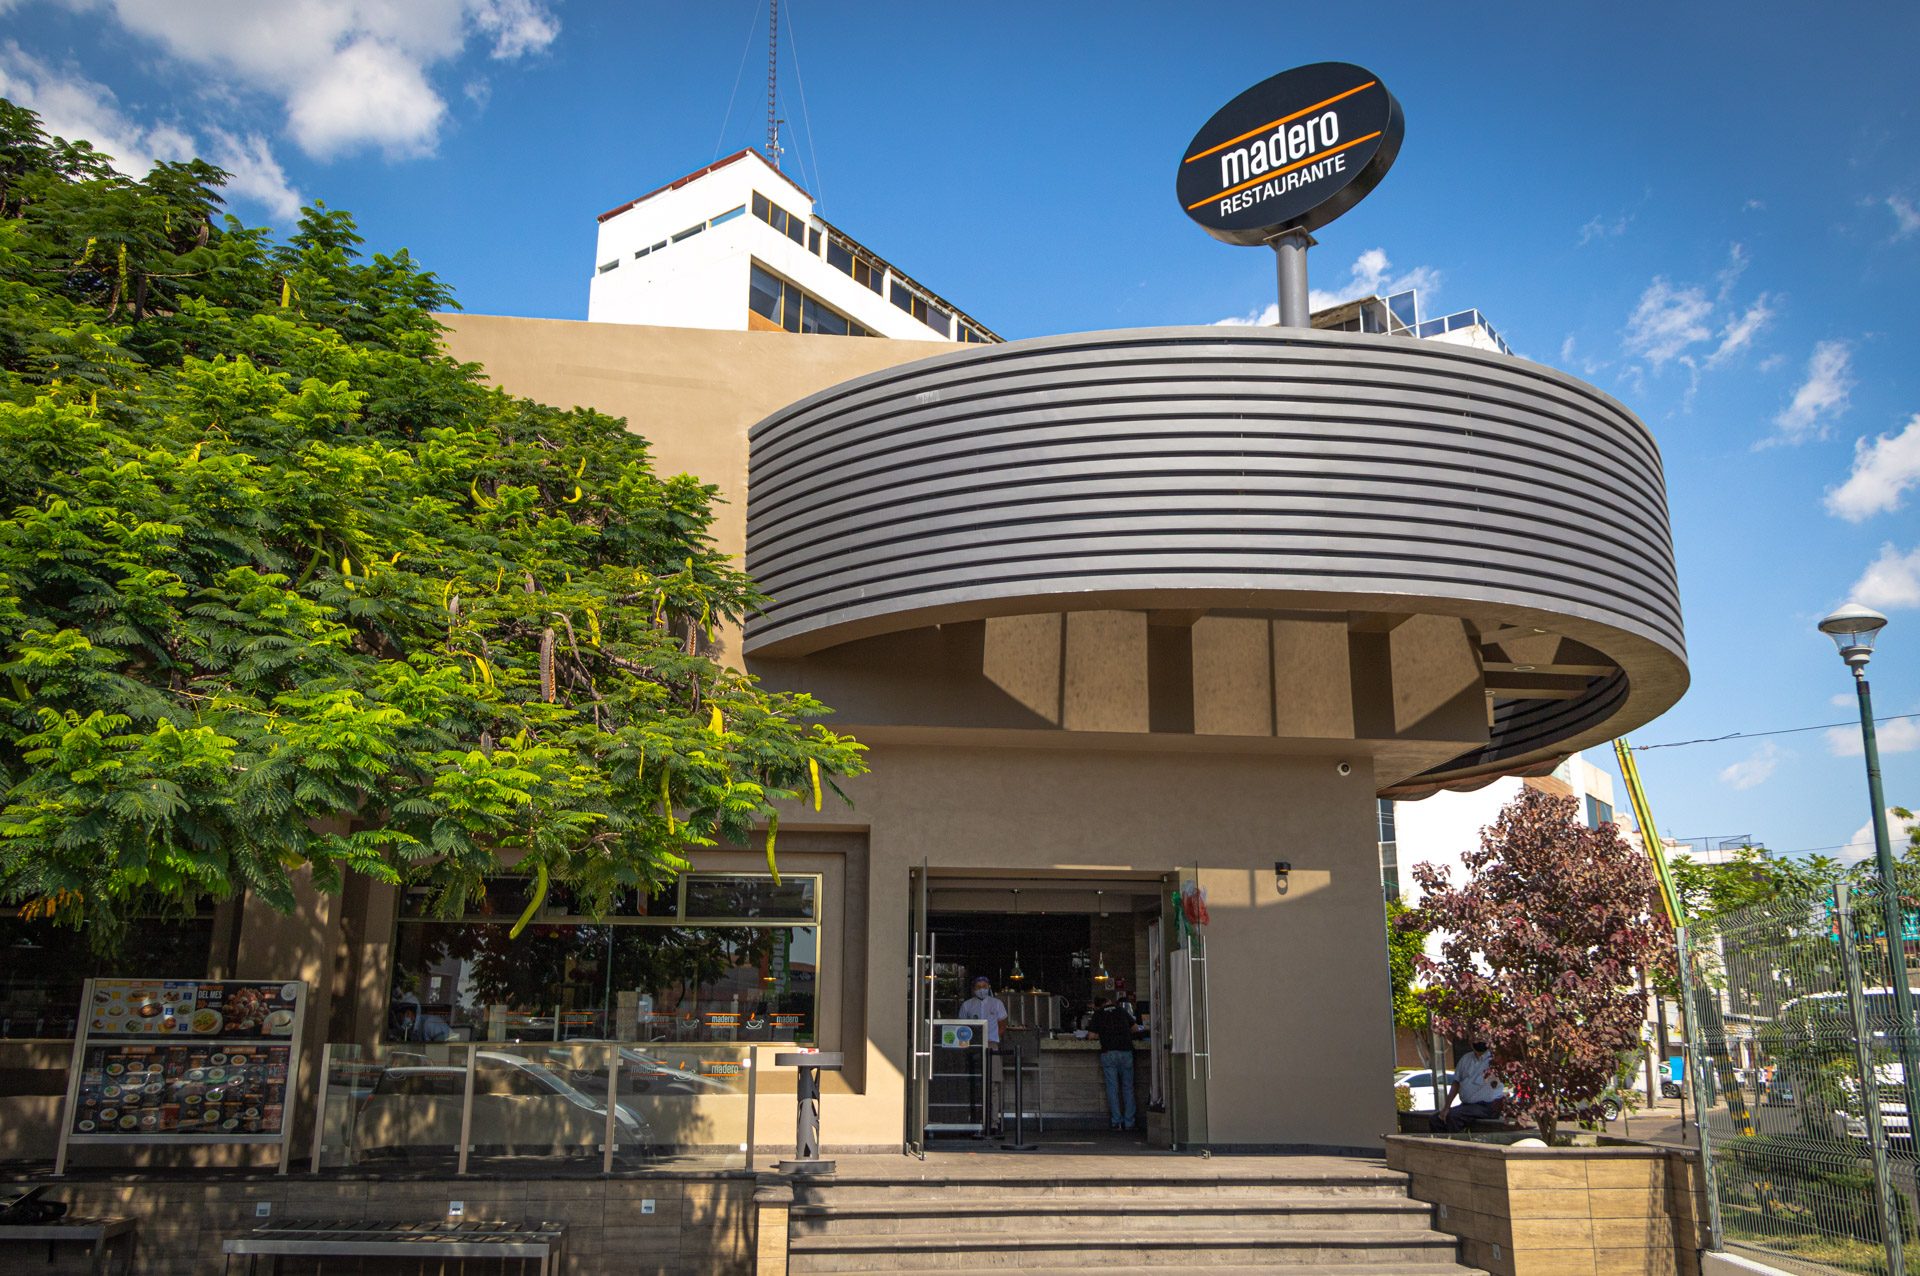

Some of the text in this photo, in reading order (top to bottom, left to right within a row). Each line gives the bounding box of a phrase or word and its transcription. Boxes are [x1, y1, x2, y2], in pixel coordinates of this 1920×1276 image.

[1221, 110, 1339, 188] madero
[1220, 153, 1346, 216] RESTAURANTE
[198, 990, 223, 999] DEL MES
[711, 1014, 734, 1023] madero
[776, 1014, 799, 1023] madero
[711, 1063, 739, 1074] madero
